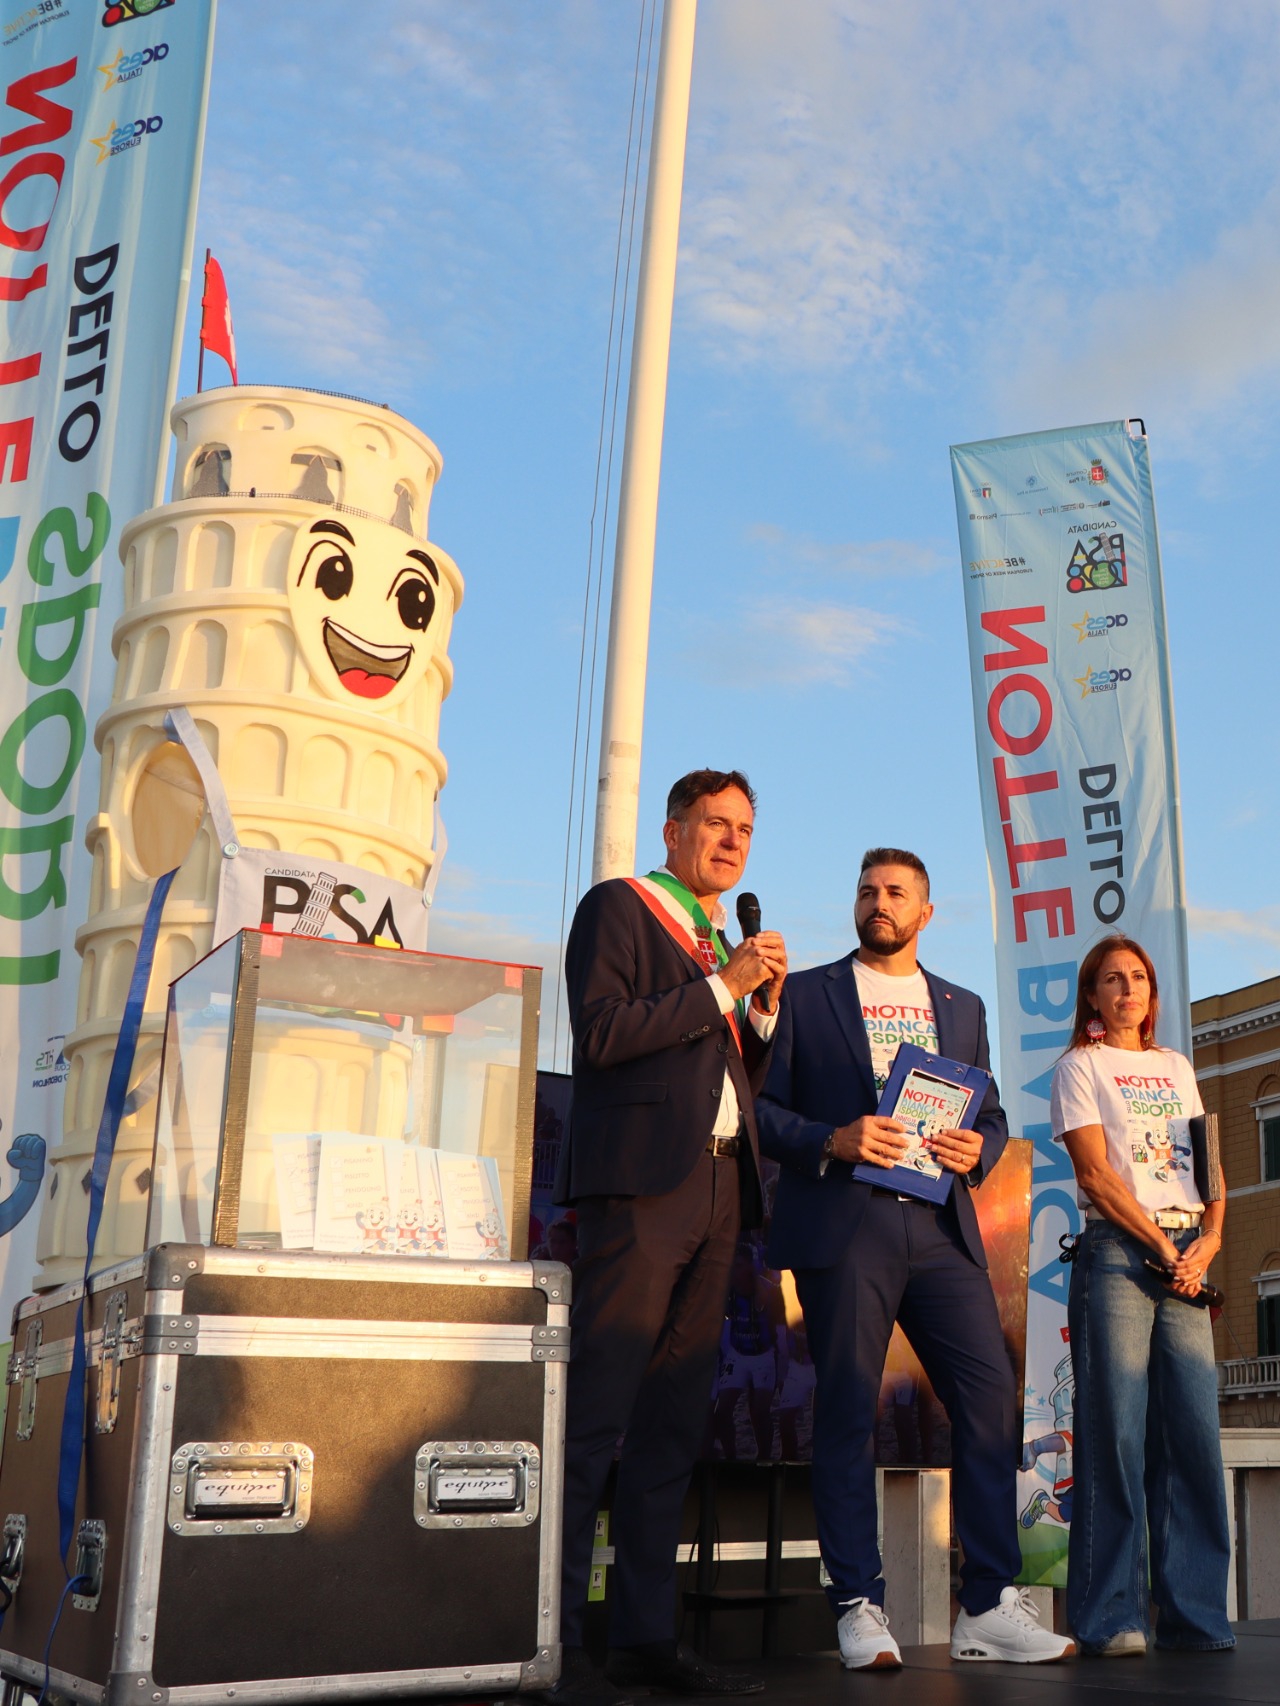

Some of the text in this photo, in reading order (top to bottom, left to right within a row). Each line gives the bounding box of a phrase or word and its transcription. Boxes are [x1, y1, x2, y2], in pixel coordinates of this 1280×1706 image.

[264, 867, 317, 878] CANDIDATA
[862, 1005, 935, 1022] NOTTE
[864, 1019, 939, 1035] BIANCA
[1114, 1075, 1175, 1088] NOTTE
[903, 1088, 947, 1110] NOTTE
[1120, 1088, 1180, 1102] BIANCA
[900, 1098, 936, 1115] BIANCA
[1131, 1100, 1183, 1117] SPORT
[900, 1107, 929, 1121] SPORT
[204, 1483, 277, 1497] equipe
[444, 1481, 508, 1494] equipe
[597, 1520, 604, 1530] F
[594, 1572, 601, 1582] F
